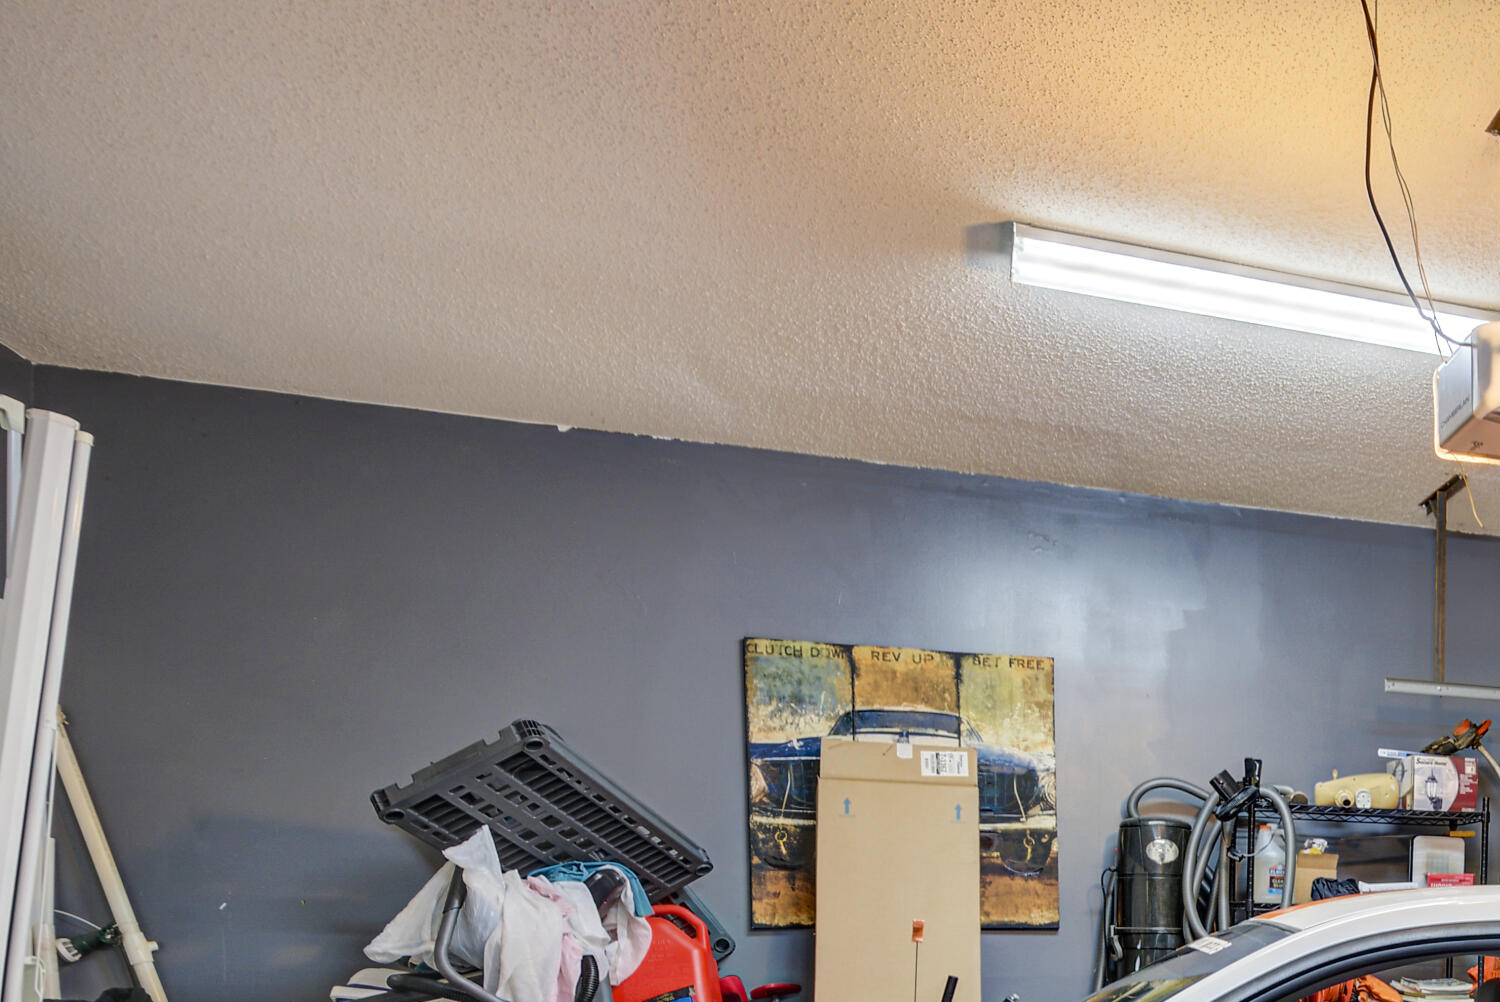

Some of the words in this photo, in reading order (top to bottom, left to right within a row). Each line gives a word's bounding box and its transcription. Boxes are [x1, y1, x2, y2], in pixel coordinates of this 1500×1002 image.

[746, 642, 803, 658] CLUTCH
[871, 650, 902, 663] REV
[911, 654, 934, 665] UP
[1008, 657, 1045, 671] FREE
